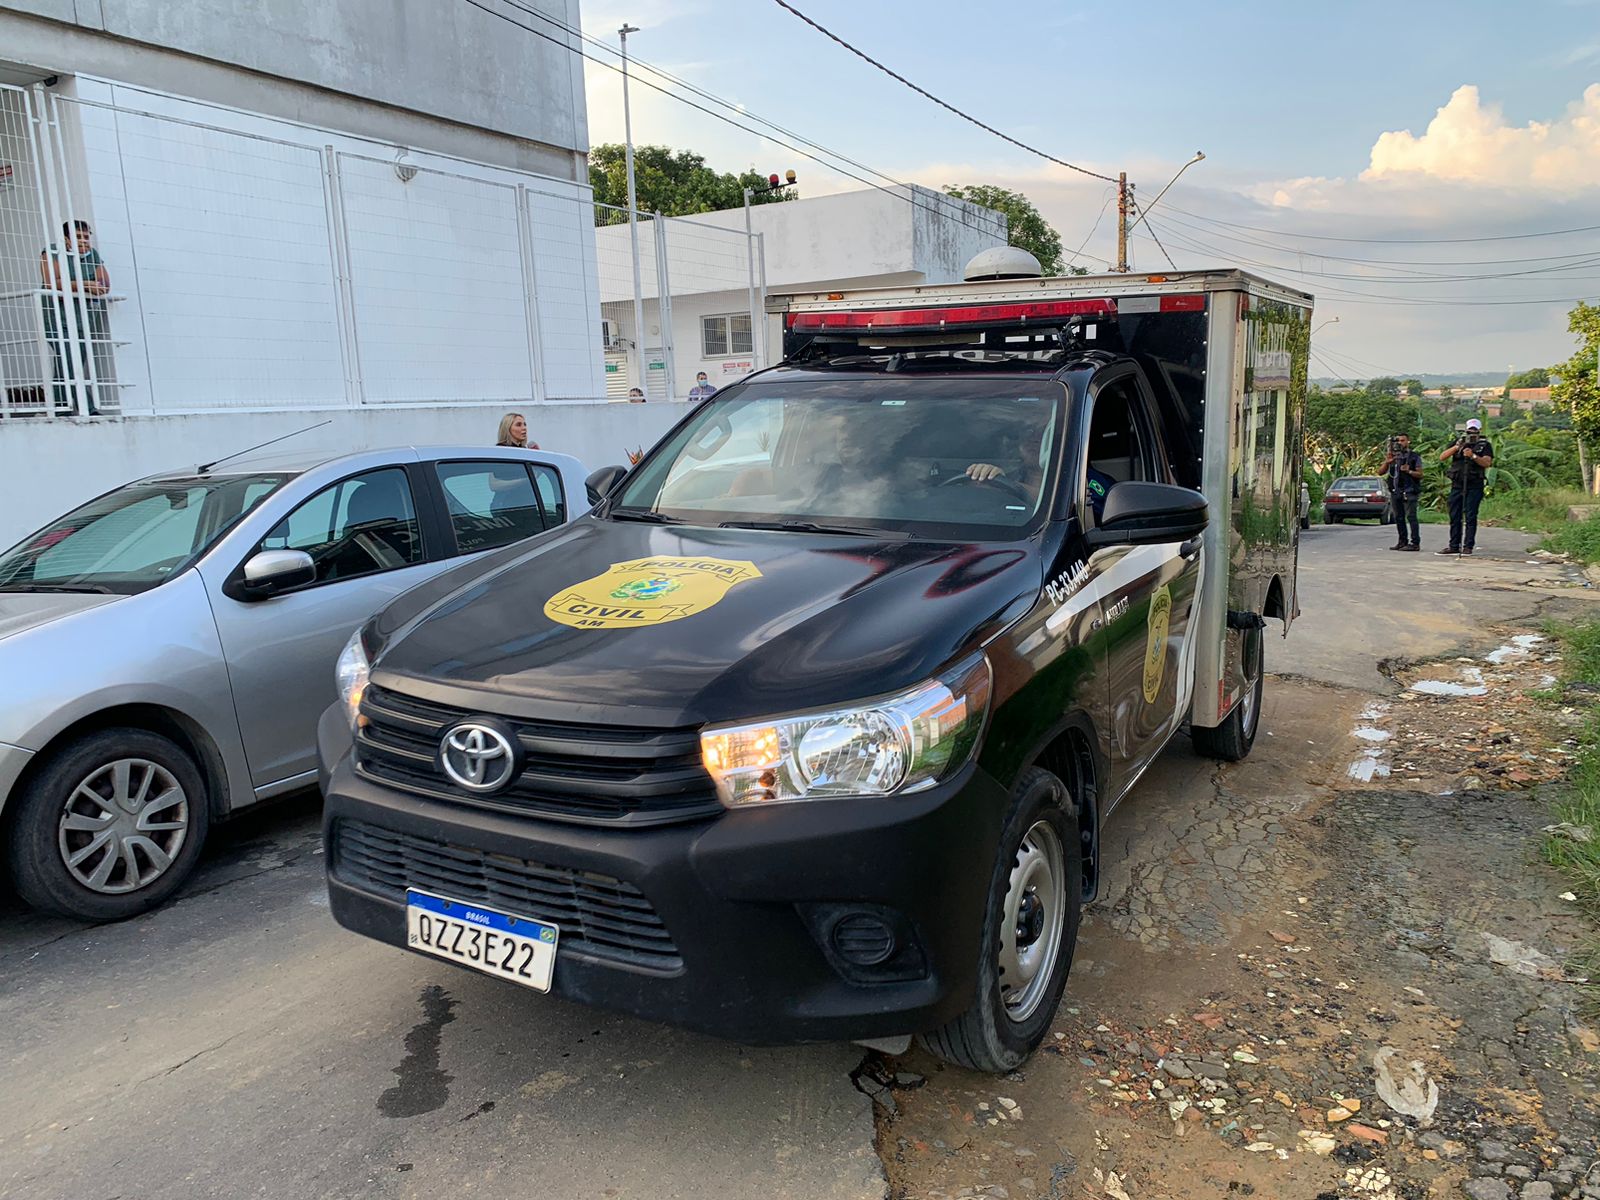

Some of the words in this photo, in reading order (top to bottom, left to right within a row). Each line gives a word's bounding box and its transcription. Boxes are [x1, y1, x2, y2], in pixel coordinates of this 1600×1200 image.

[568, 604, 646, 619] CIVIL
[576, 619, 606, 627] AM
[465, 911, 491, 925] BRASIL
[419, 913, 534, 979] QZZ3E22
